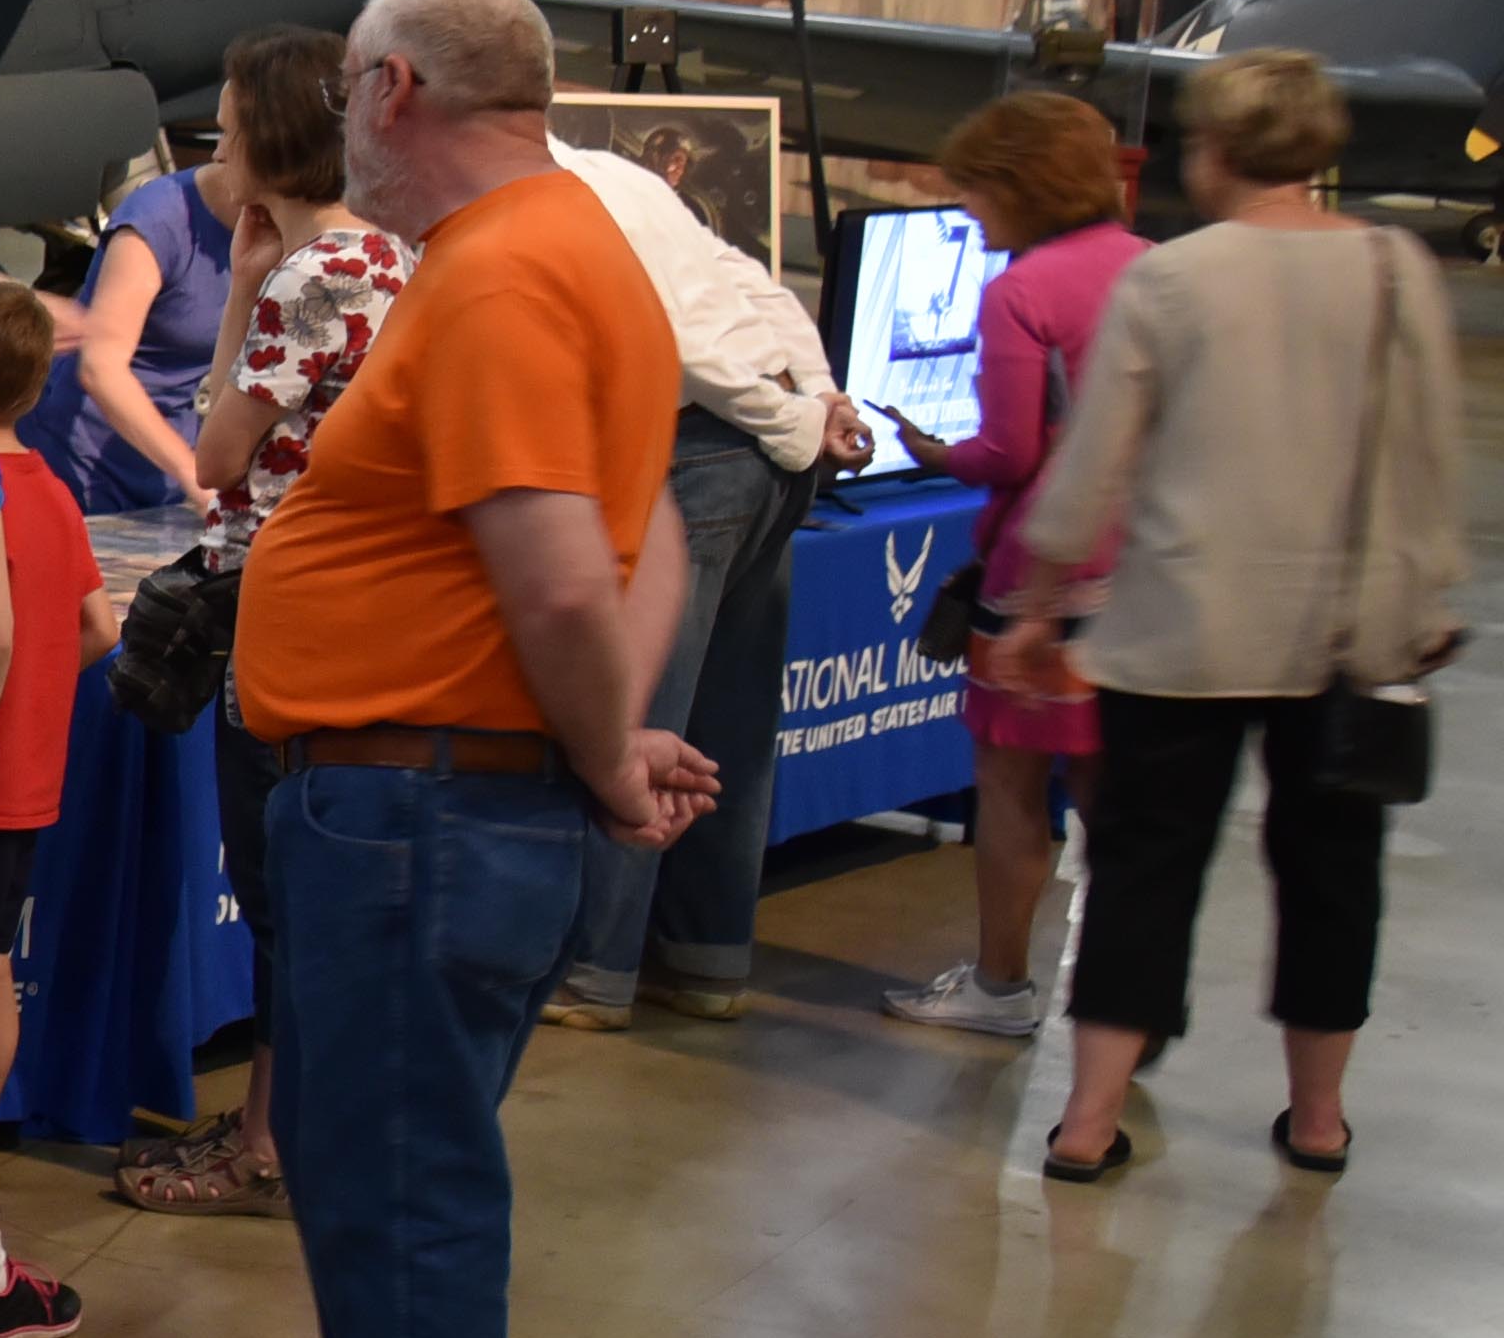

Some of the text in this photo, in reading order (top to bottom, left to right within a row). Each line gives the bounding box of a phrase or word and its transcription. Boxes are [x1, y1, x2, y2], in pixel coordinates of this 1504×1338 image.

[781, 643, 889, 714] ATIONAL
[804, 713, 867, 753] UNITED
[870, 697, 927, 736] STATES
[926, 692, 957, 721] AIR
